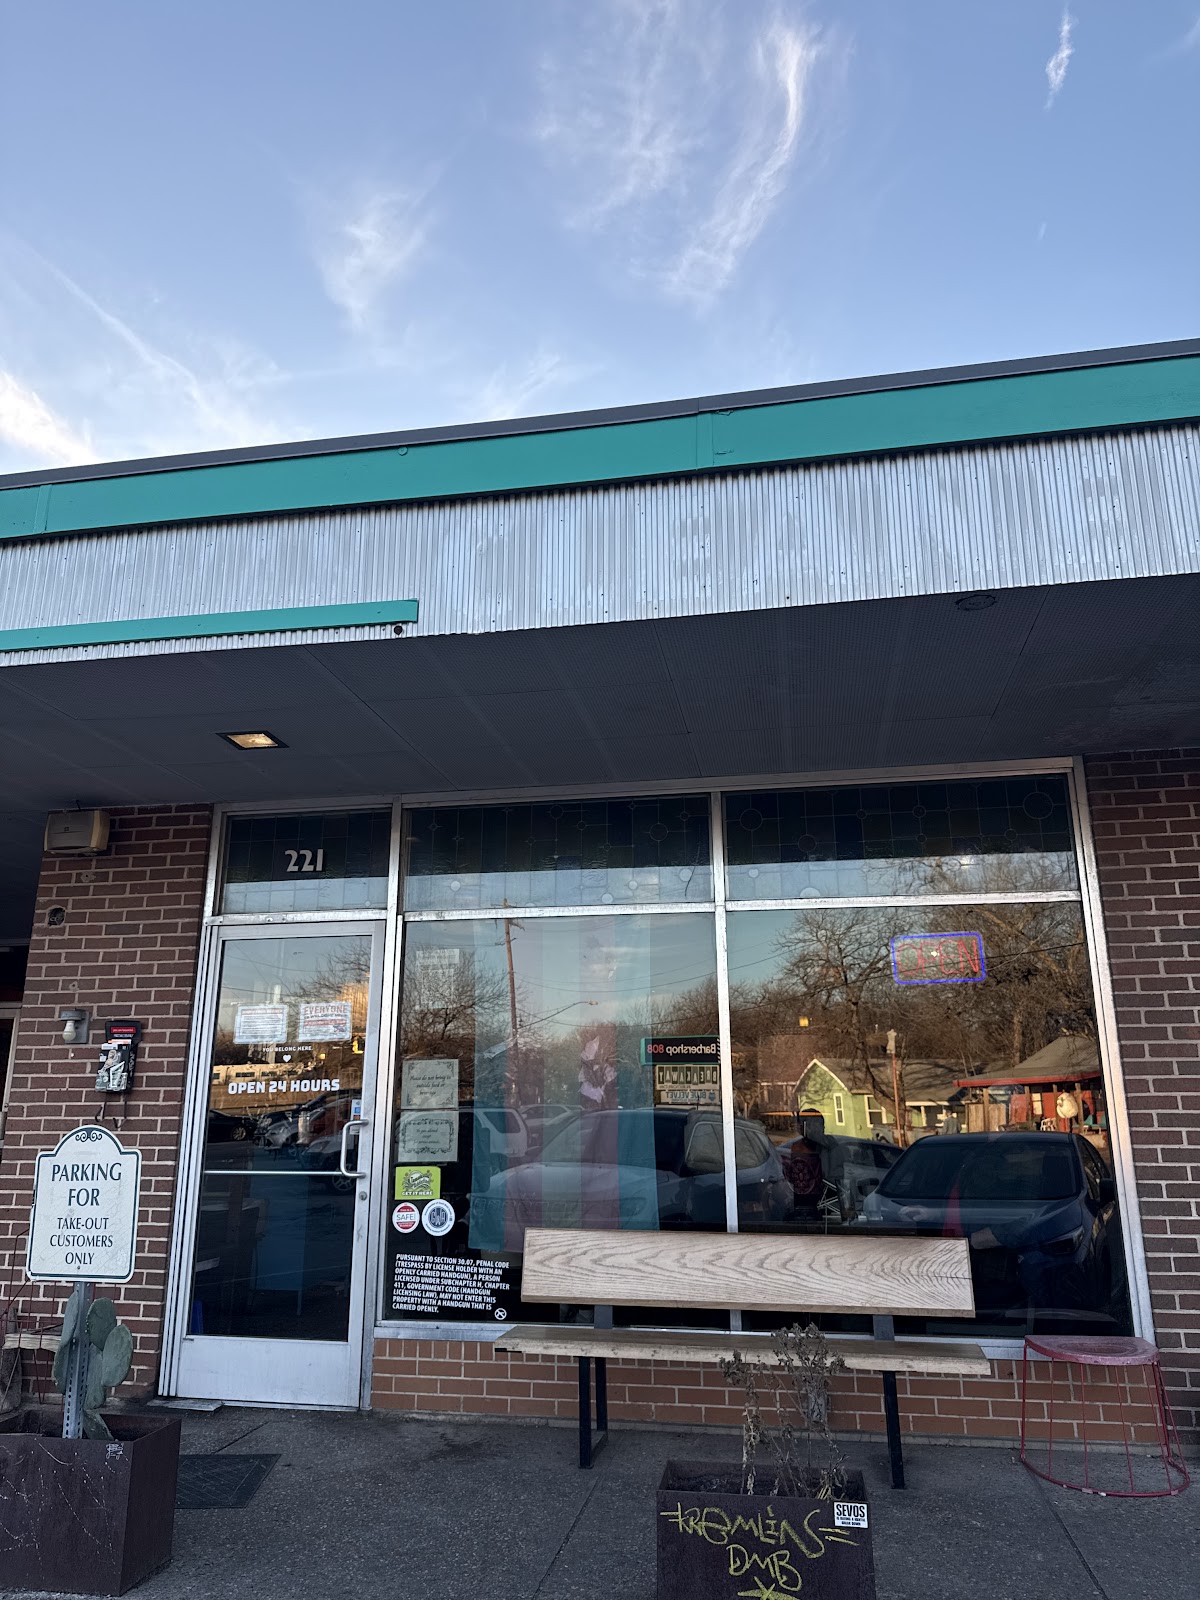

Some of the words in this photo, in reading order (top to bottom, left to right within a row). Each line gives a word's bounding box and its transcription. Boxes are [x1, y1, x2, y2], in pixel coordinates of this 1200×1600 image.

[285, 849, 324, 871] 221
[897, 940, 979, 975] OPEN
[304, 1005, 348, 1015] EVERYONE
[228, 1081, 265, 1095] OPEN
[269, 1080, 287, 1093] 24
[290, 1079, 340, 1092] HOURS
[52, 1163, 122, 1182] PARKING
[68, 1188, 100, 1206] FOR
[57, 1218, 109, 1230] TAKE-OUT
[50, 1235, 113, 1247] CUSTOMERS
[65, 1252, 95, 1264] ONLY
[434, 1256, 457, 1264] SECTION
[395, 1261, 424, 1269] (TRESPASS
[433, 1263, 454, 1271] LICENSE
[455, 1265, 477, 1273] HOLDER
[417, 1269, 440, 1277] CARRIED
[407, 1283, 444, 1291] GOVERNMENT
[445, 1285, 459, 1293] CODE
[460, 1286, 490, 1295] (HANDGUN
[441, 1278, 476, 1287] SUBCHAPTER
[484, 1282, 510, 1290] CHAPTER
[423, 1291, 438, 1299] LAW),
[392, 1303, 416, 1311] CARRIED
[393, 1296, 420, 1304] PROPERTY
[443, 1300, 470, 1308] HANDGUN
[836, 1504, 865, 1518] SEVOS
